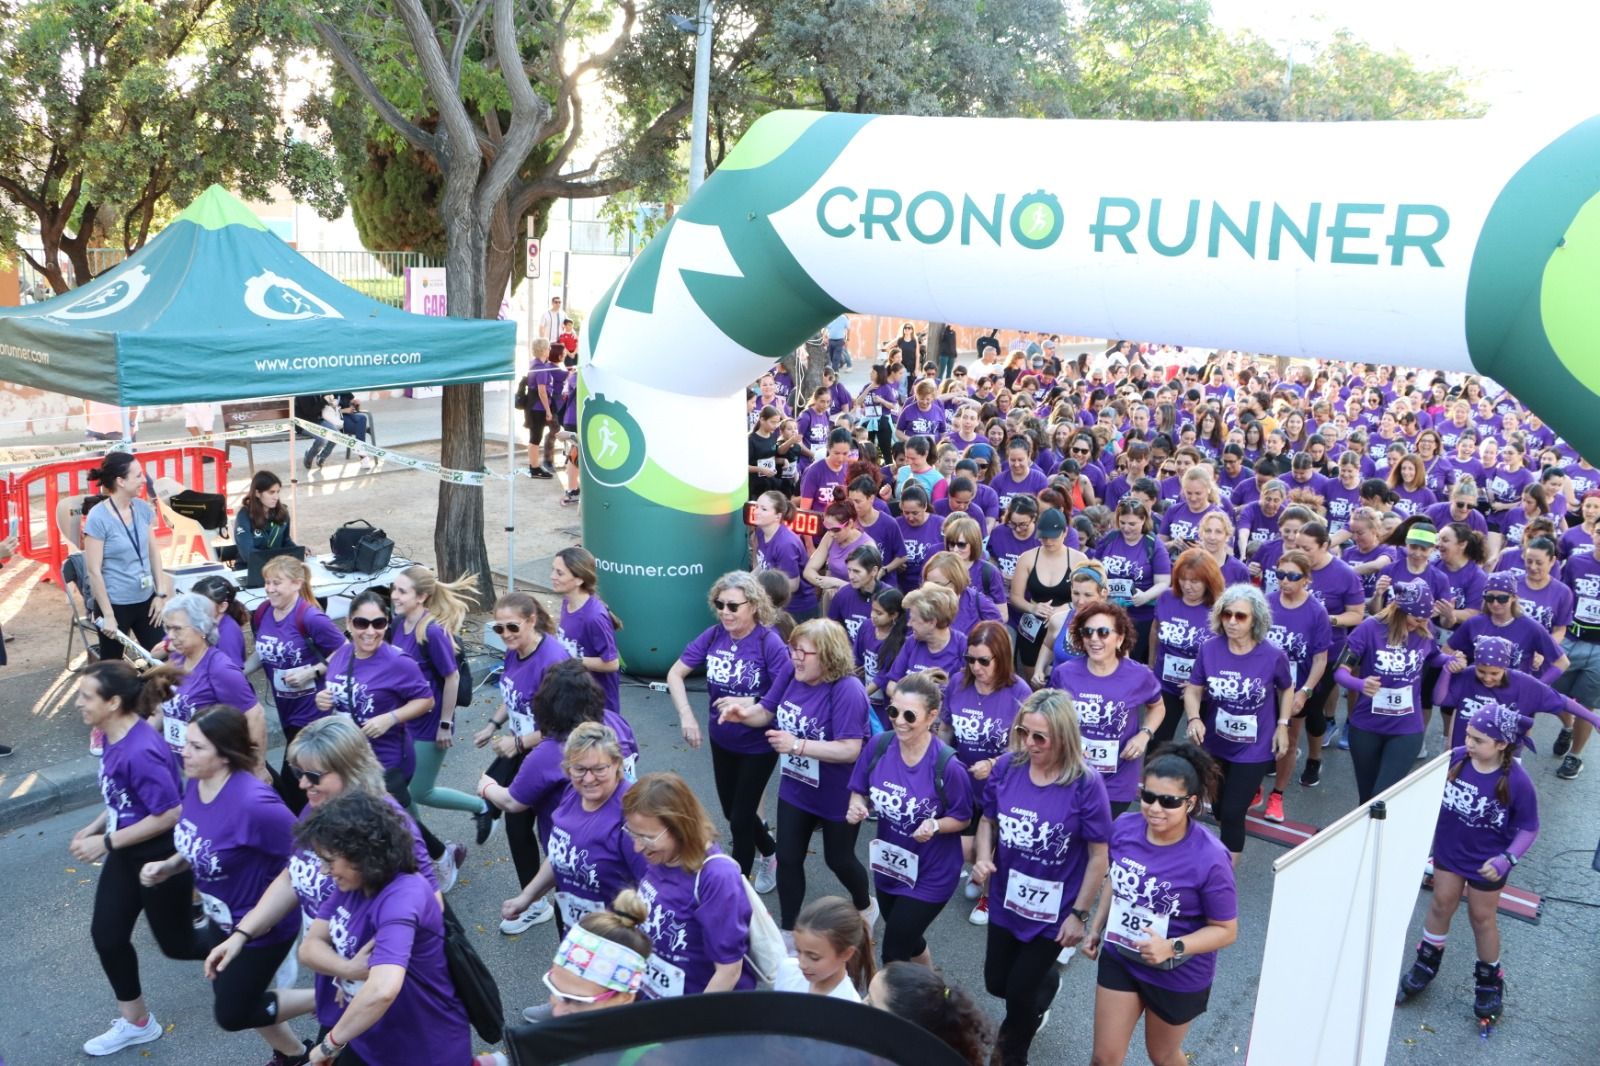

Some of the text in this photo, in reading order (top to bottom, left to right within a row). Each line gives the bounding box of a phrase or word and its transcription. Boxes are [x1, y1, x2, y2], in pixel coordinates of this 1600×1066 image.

[816, 185, 1450, 268] CRONO RUNNER
[254, 351, 422, 372] www.cronorunner.com
[1108, 584, 1126, 593] 306
[1386, 695, 1402, 705] 18
[1224, 720, 1248, 731] 145
[788, 753, 810, 770] 234
[881, 850, 908, 869] 374
[1018, 884, 1050, 903] 377
[1121, 912, 1153, 931] 287
